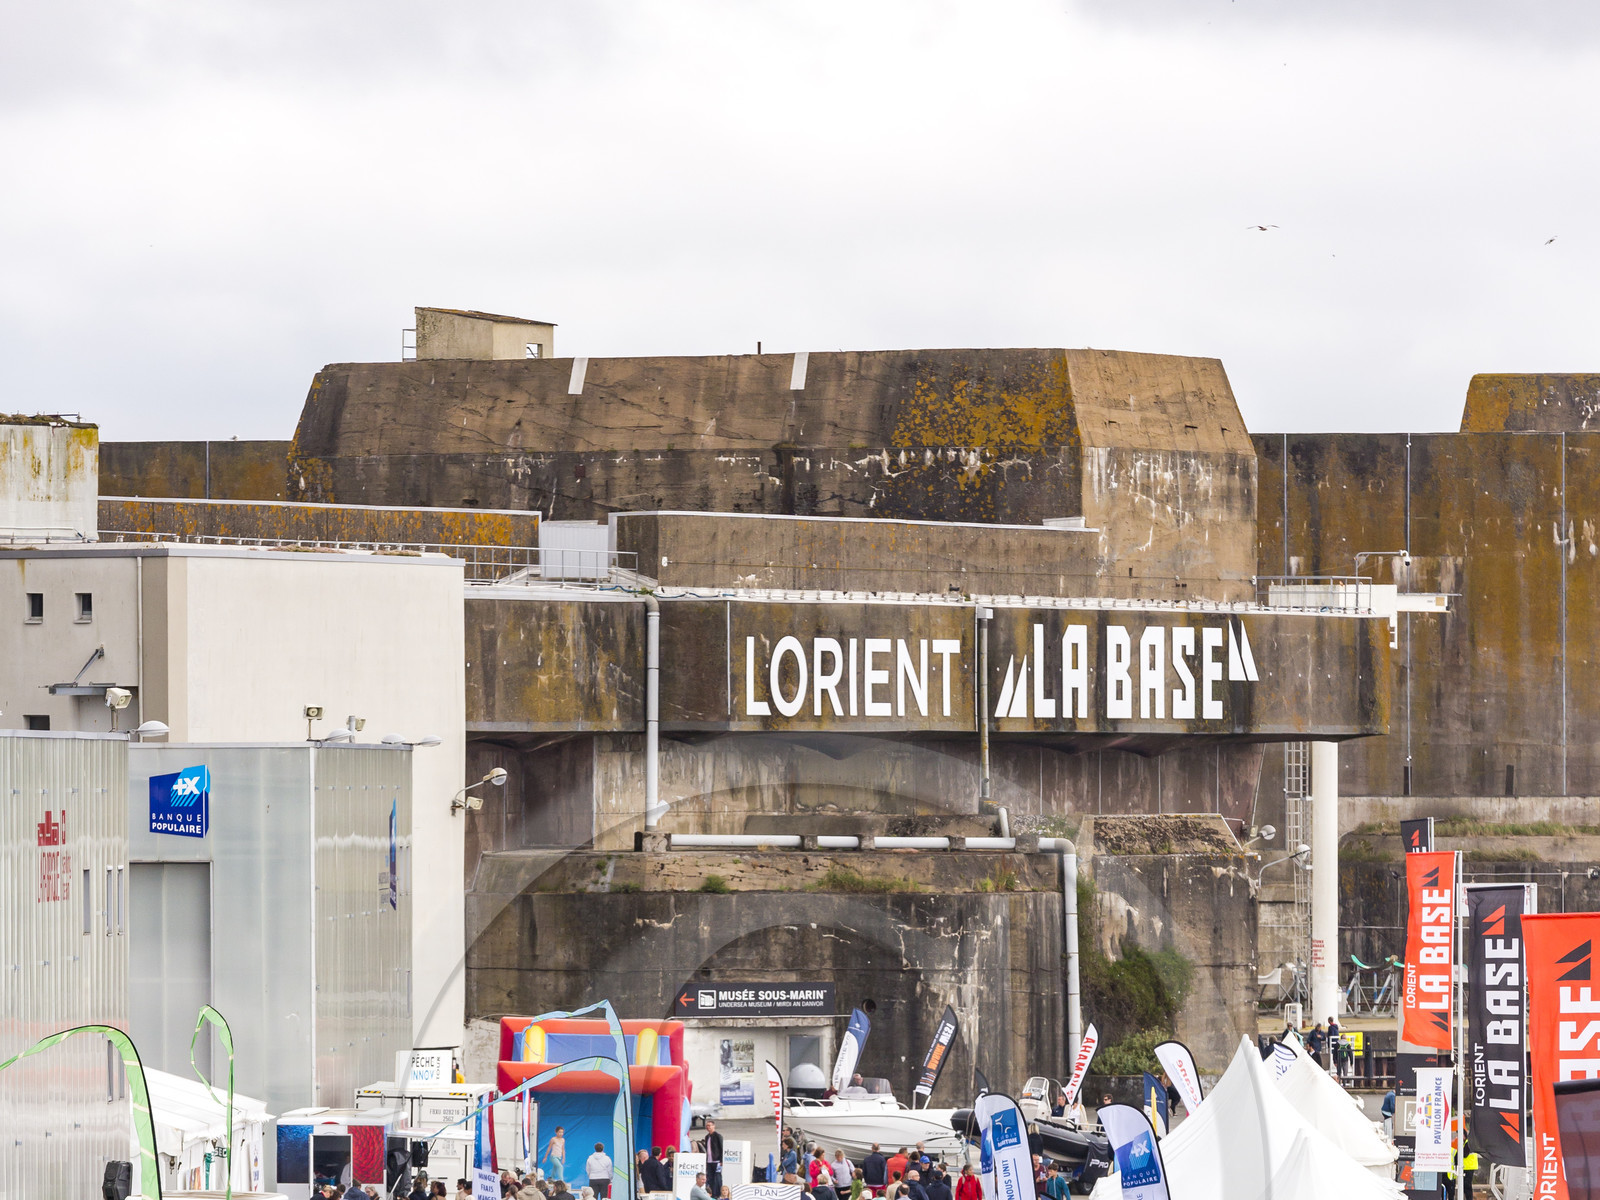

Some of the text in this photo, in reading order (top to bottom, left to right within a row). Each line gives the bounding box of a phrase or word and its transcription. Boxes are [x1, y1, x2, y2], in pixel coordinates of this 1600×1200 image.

[745, 635, 961, 718] LORIENT
[1034, 624, 1224, 720] LA BASE
[151, 812, 202, 823] BANQUE
[151, 822, 202, 834] POPULAIRE
[1419, 889, 1451, 964] BASE
[718, 989, 756, 1001] MUSÉE
[1406, 963, 1416, 1009] LORIENT
[1419, 975, 1450, 1010] LA
[1484, 937, 1520, 1110] LA BASE
[411, 1054, 435, 1068] PÊCHE
[410, 1069, 435, 1081] INNOV
[1475, 1042, 1487, 1107] LORIENT
[1435, 1077, 1443, 1107] FRANCE
[1001, 1159, 1012, 1178] UNIT
[1006, 1179, 1016, 1200] NOUS
[1123, 1176, 1159, 1187] POPULAIRE
[754, 1188, 778, 1197] PLAN
